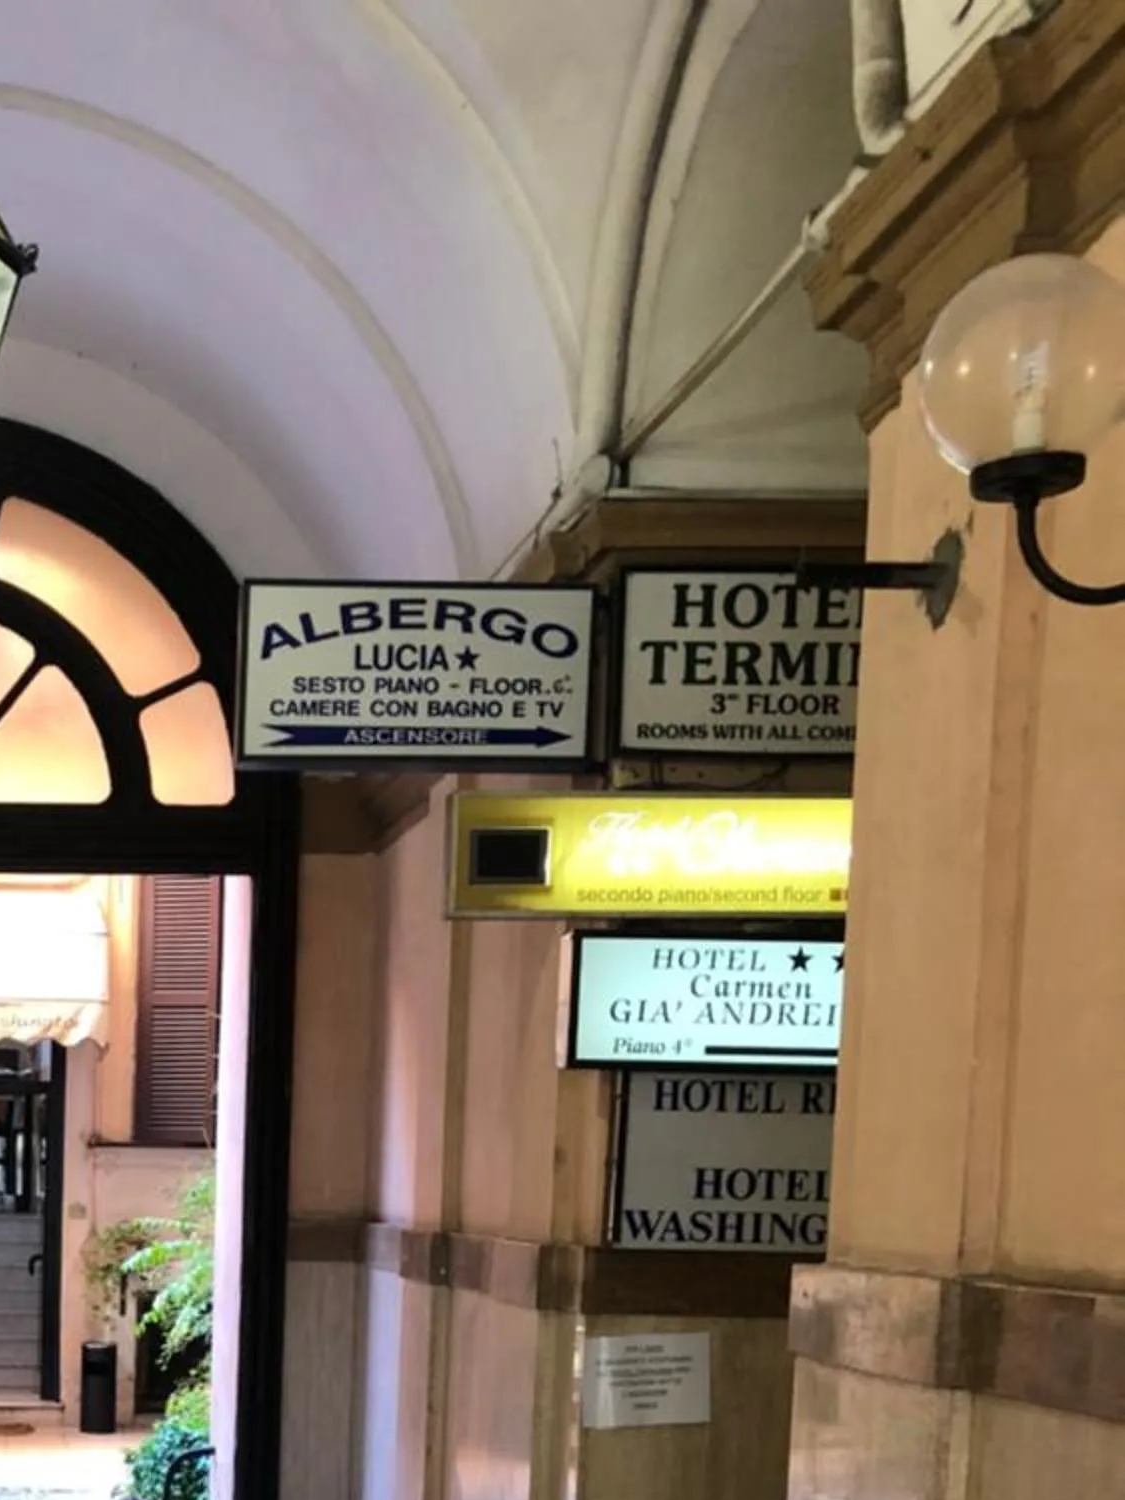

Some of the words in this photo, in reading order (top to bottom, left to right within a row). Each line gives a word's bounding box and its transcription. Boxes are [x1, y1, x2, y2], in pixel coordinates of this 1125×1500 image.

[672, 583, 863, 630] HOTE
[261, 598, 579, 660] ALBERGO
[354, 644, 449, 671] LUCIA
[293, 677, 365, 694] SESTO
[375, 677, 439, 694] PIANO
[270, 699, 360, 717] CAMERE
[370, 700, 418, 717] CON
[427, 700, 503, 718] BAGNO
[513, 701, 527, 718] E
[536, 701, 565, 718] TV
[747, 694, 840, 715] FLOOR
[344, 729, 488, 745] ASCENSORE
[637, 723, 708, 740] ROOMS
[712, 724, 763, 740] WITH
[767, 725, 802, 740] ALL
[577, 886, 653, 902] secondo
[782, 885, 822, 902] floor
[653, 947, 767, 972] HOTEL
[690, 974, 812, 999] Carmen
[693, 1001, 838, 1027] ANDREI
[613, 1037, 666, 1055] Piano
[653, 1078, 785, 1114] HOTEL
[624, 1209, 828, 1245] WASHING
